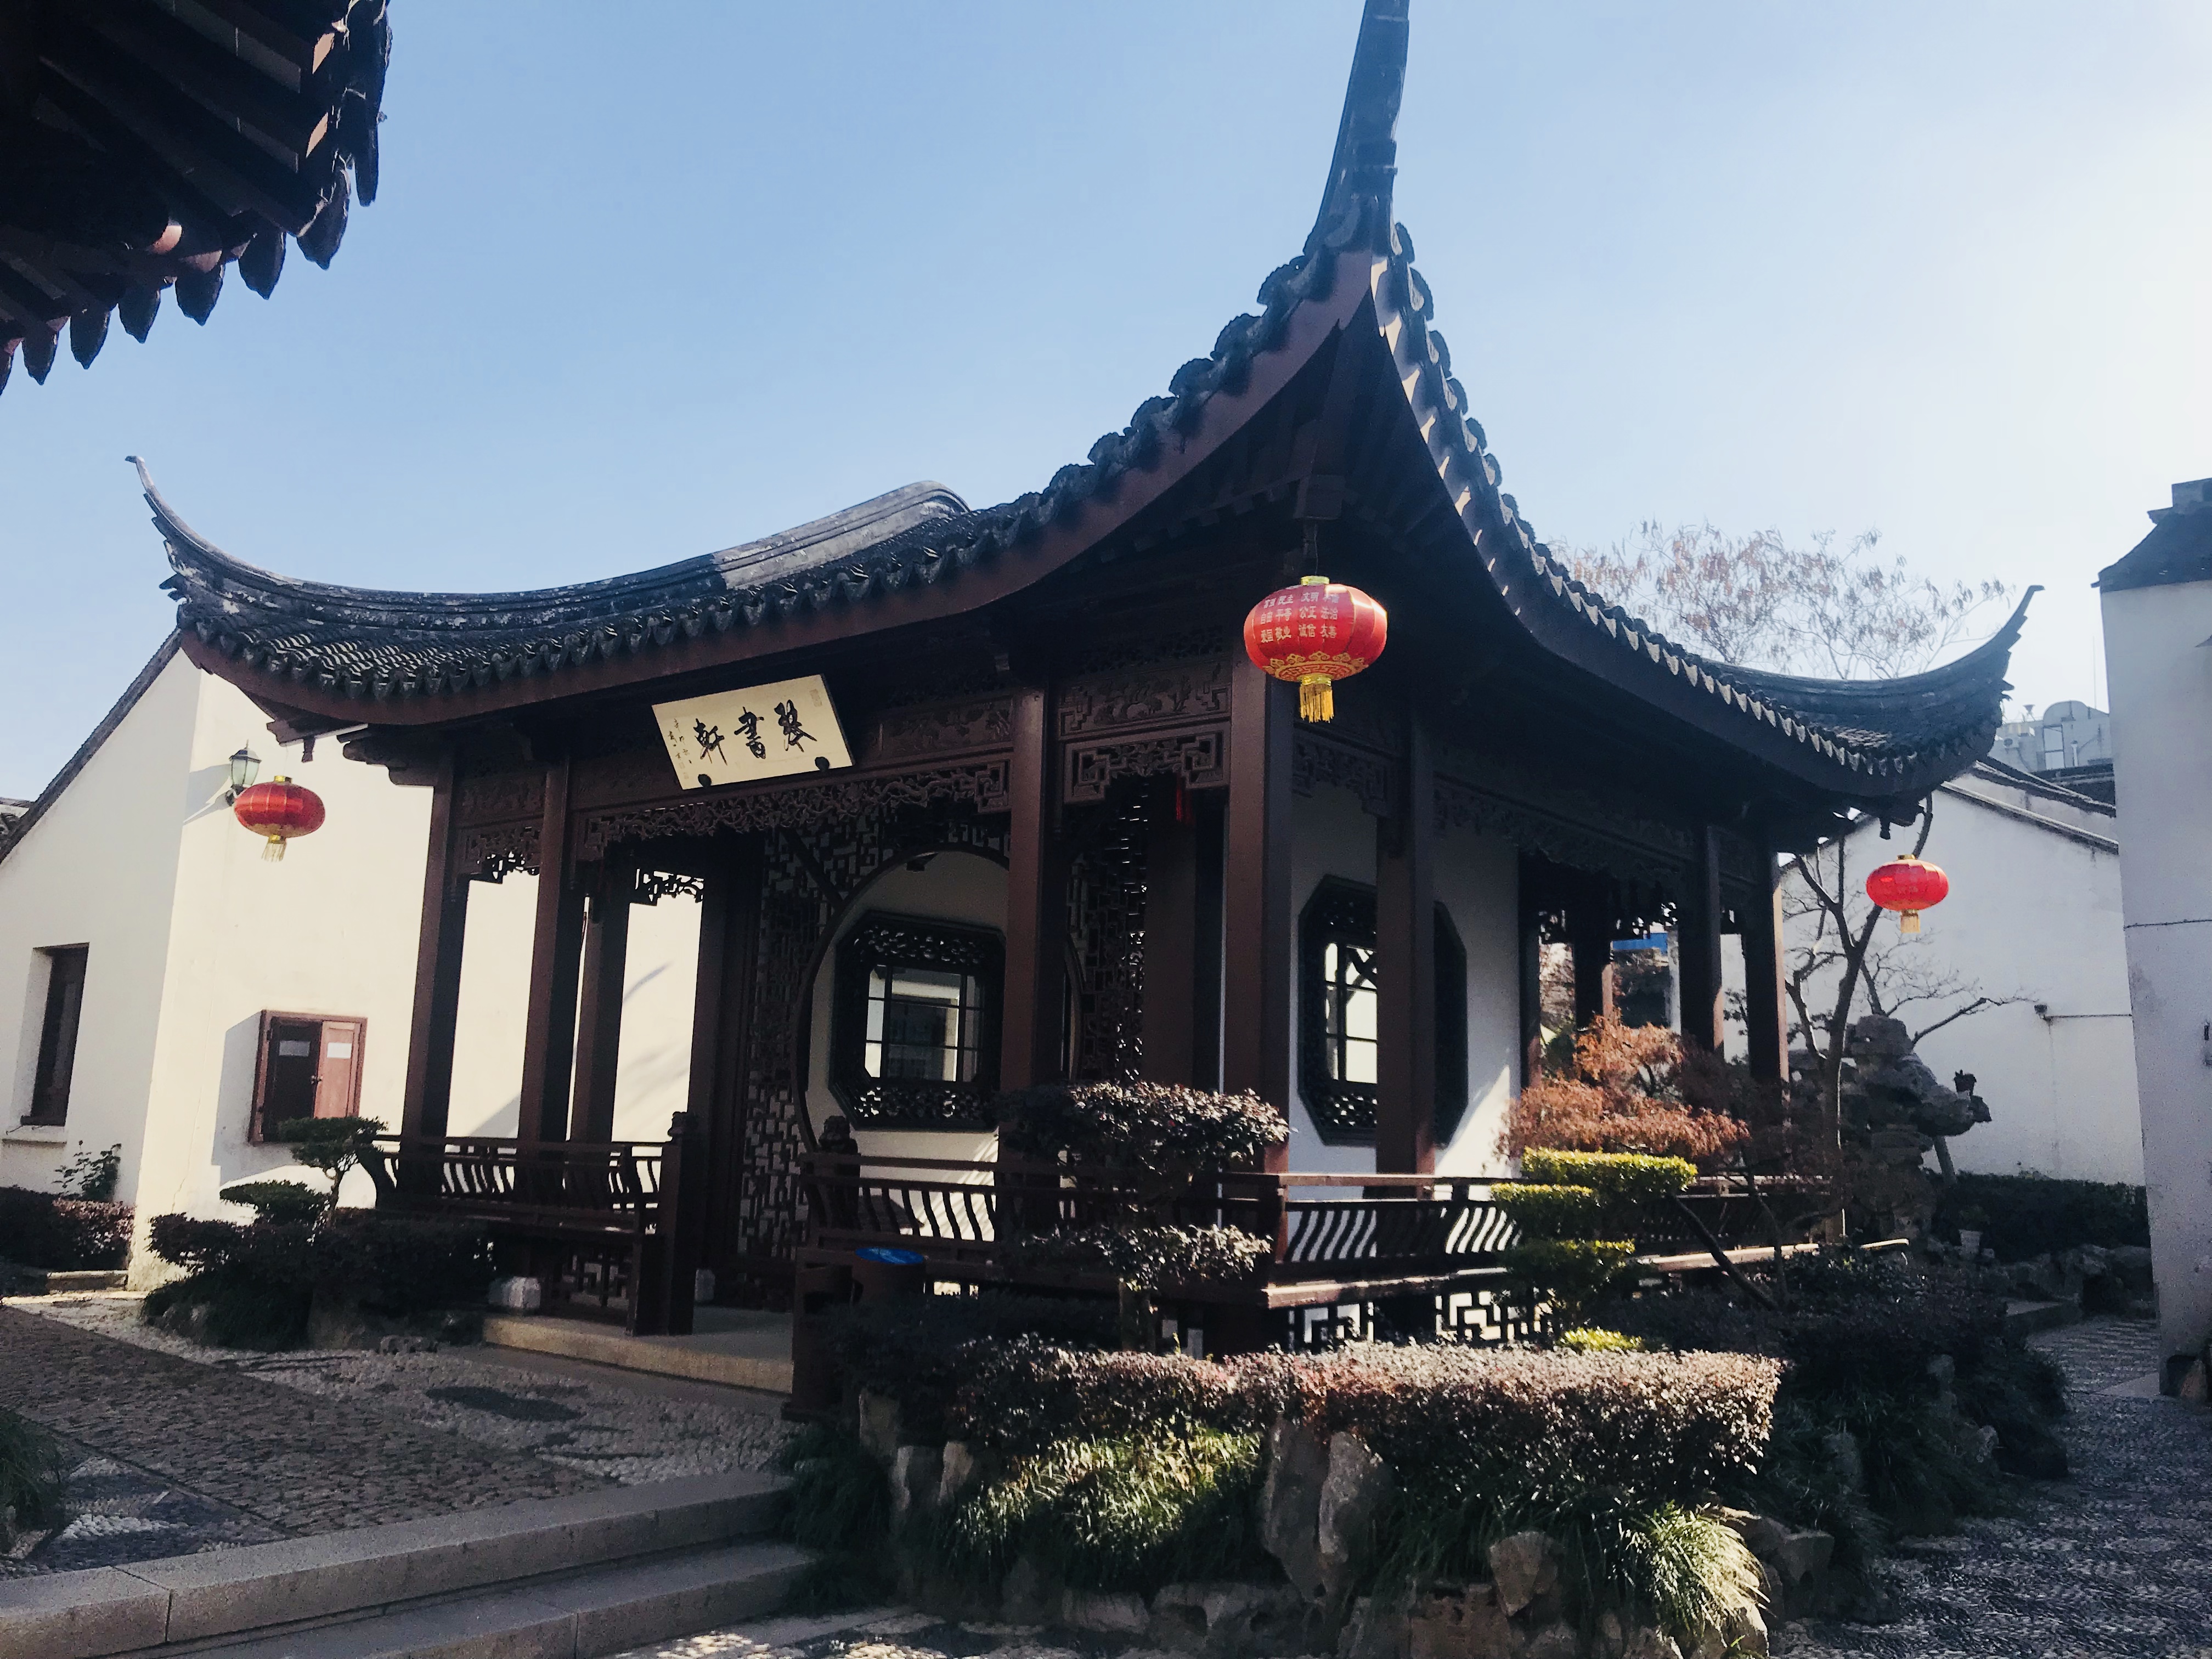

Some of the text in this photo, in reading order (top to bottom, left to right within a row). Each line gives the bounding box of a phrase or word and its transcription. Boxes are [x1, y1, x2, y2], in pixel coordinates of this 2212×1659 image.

[1278, 594, 1294, 605] 民主
[1301, 592, 1319, 602] 文明
[1299, 605, 1317, 619] 公正
[1321, 606, 1339, 620] 法治
[1298, 623, 1316, 637] 诚信
[1320, 623, 1337, 639] 友善
